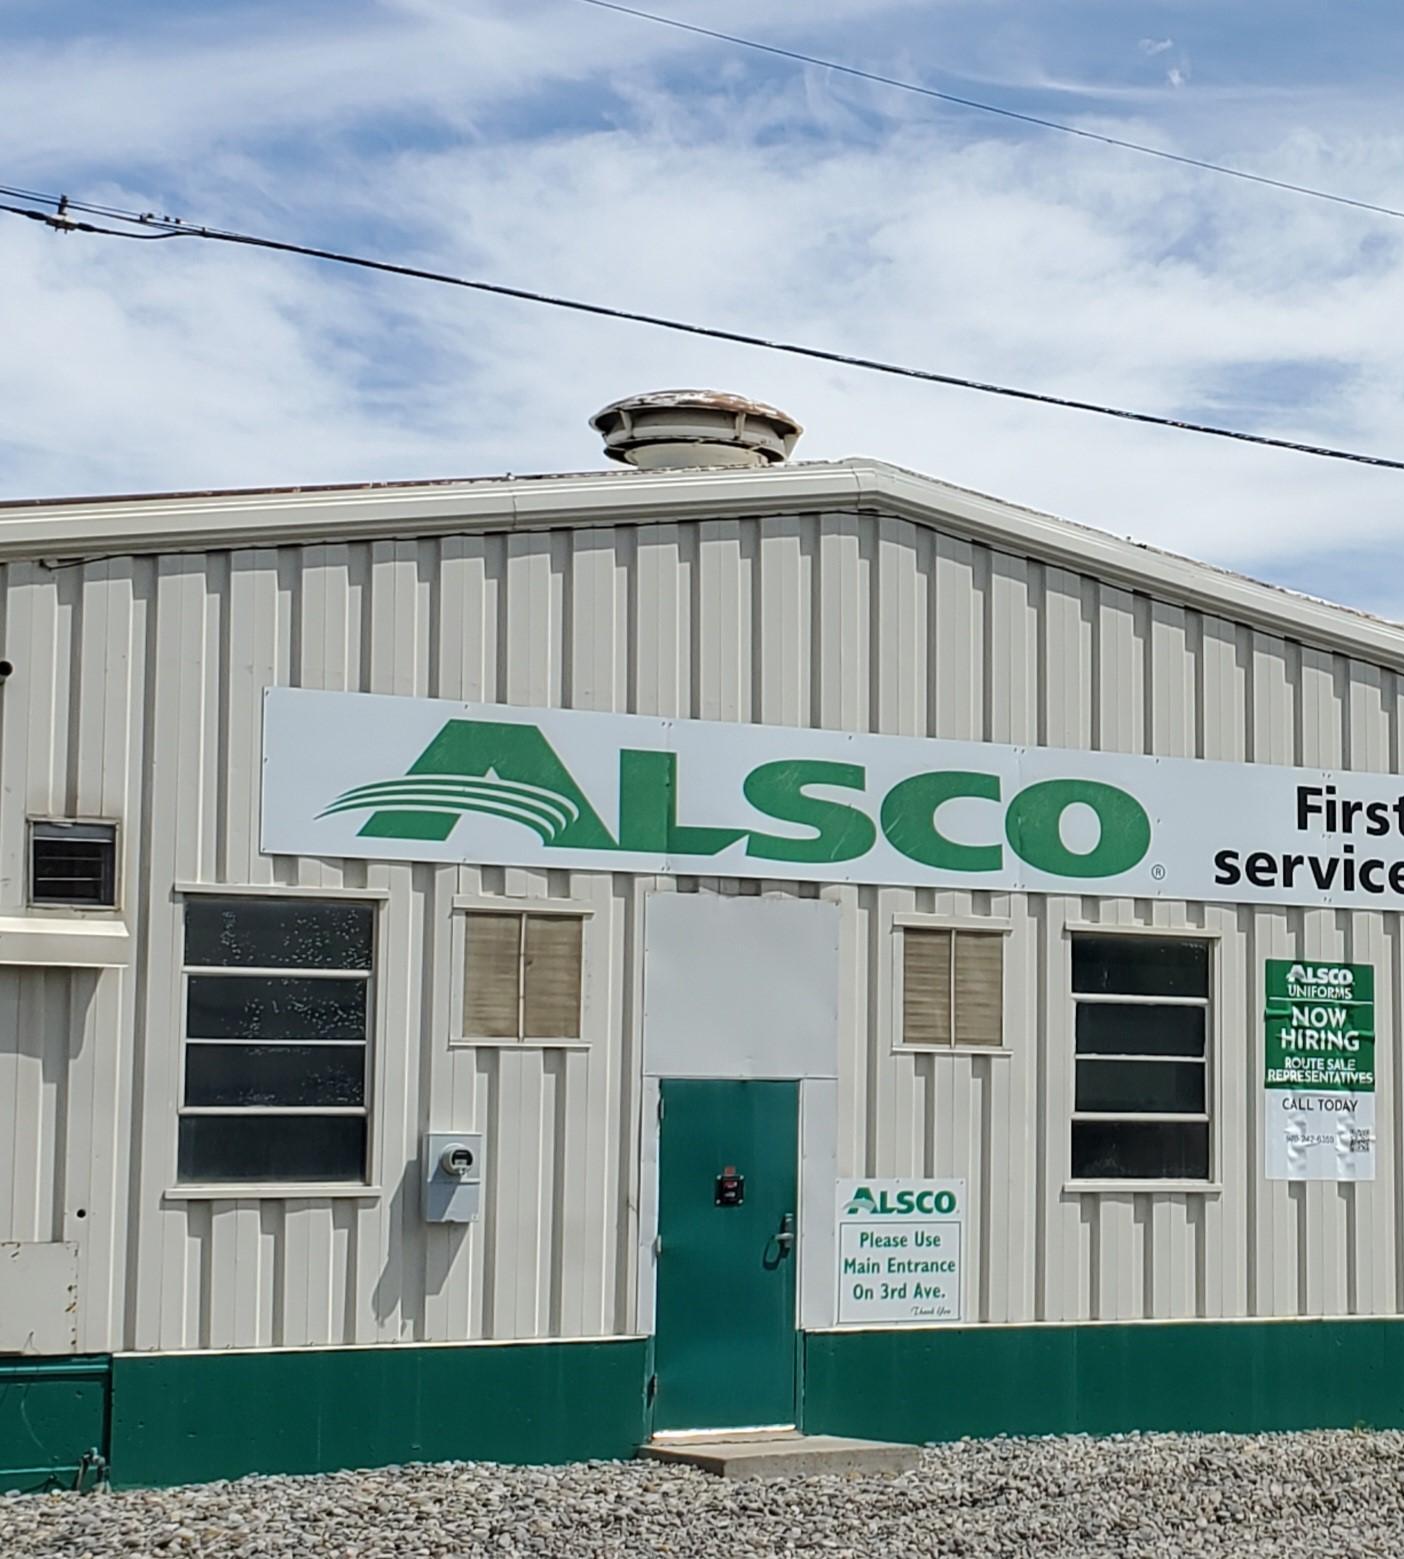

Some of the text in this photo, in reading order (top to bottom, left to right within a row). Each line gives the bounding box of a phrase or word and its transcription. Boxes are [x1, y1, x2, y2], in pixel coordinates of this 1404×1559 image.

[313, 719, 1152, 877] ALSCO
[1286, 964, 1353, 985] ALSCO
[1287, 984, 1353, 999] UNIFORMS
[1292, 1005, 1347, 1028] NOW
[1280, 1028, 1360, 1051] HIRING
[1284, 1056, 1356, 1071] ROUTE SALE
[1267, 1069, 1373, 1084] REPRESENTATIVES
[1282, 1098, 1358, 1112] CALL TODAY
[842, 1187, 957, 1215] ALSCO
[860, 1230, 941, 1248] Please Use
[844, 1257, 956, 1274] Main Entrance
[853, 1282, 946, 1300] On 3rd Ave.
